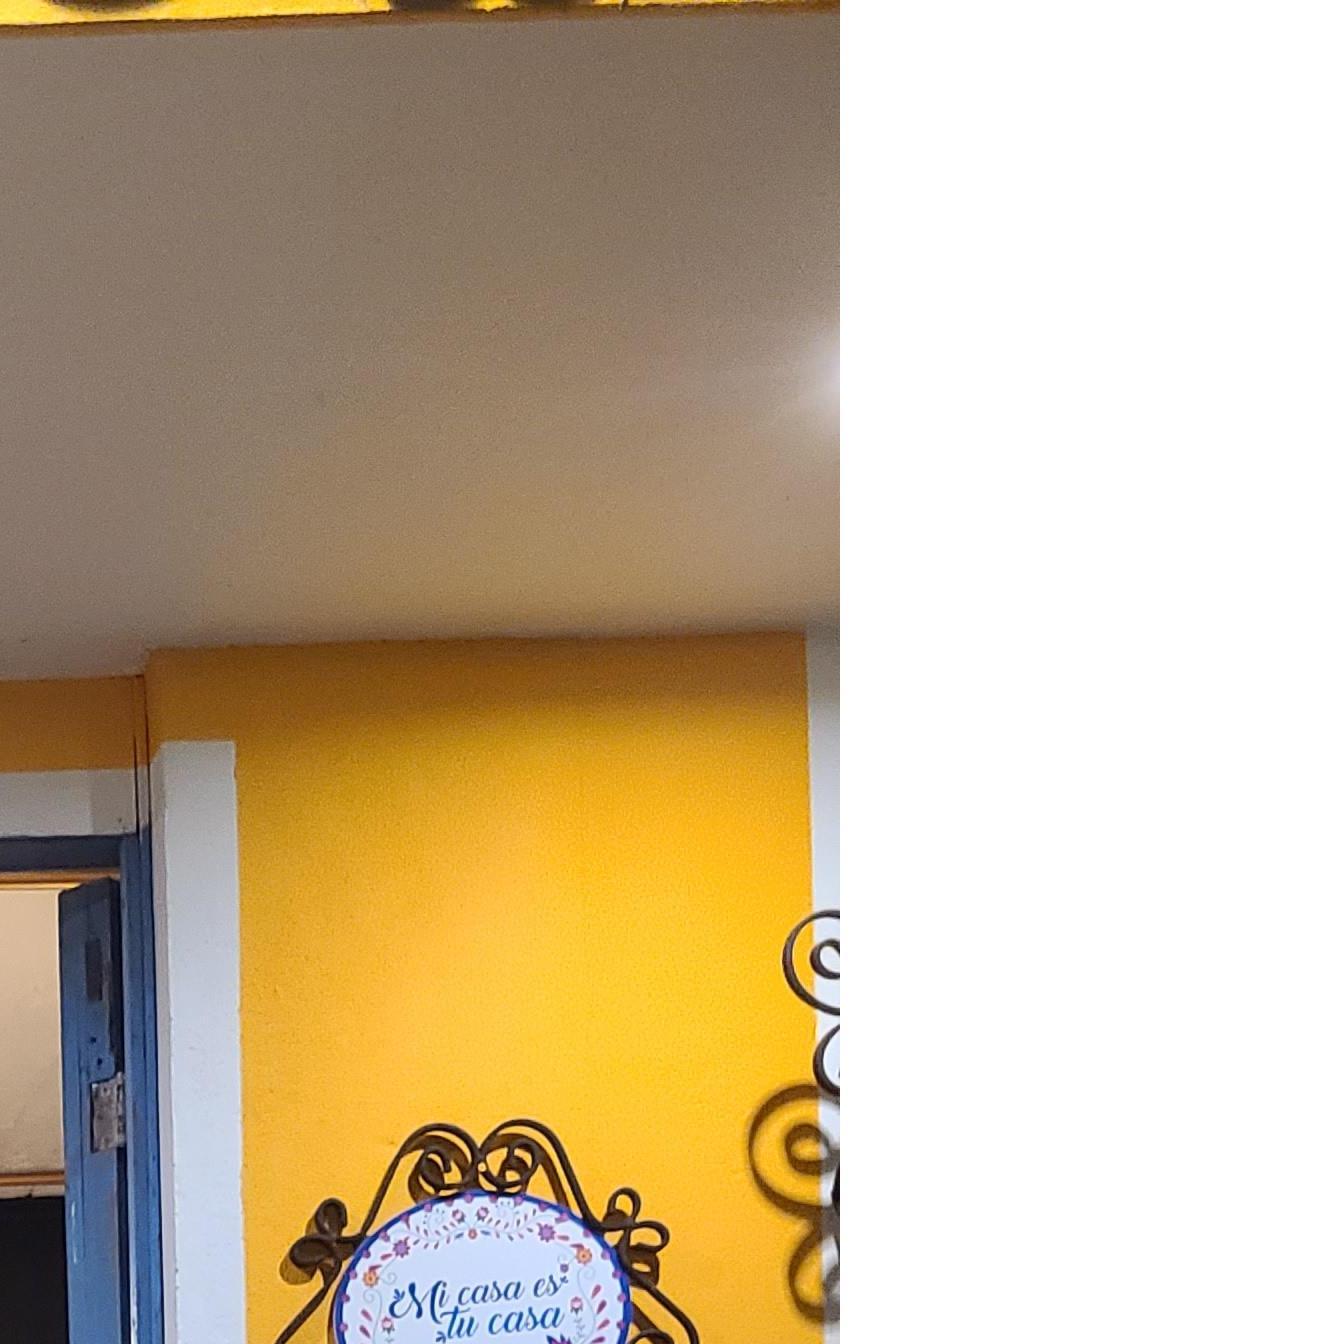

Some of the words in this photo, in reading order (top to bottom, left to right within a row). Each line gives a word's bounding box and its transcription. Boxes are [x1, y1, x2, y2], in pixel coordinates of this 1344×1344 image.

[388, 1280, 448, 1324] Mi
[457, 1280, 525, 1306] casa
[533, 1274, 563, 1298] es
[440, 1305, 479, 1340] tu
[488, 1306, 565, 1335] casa
